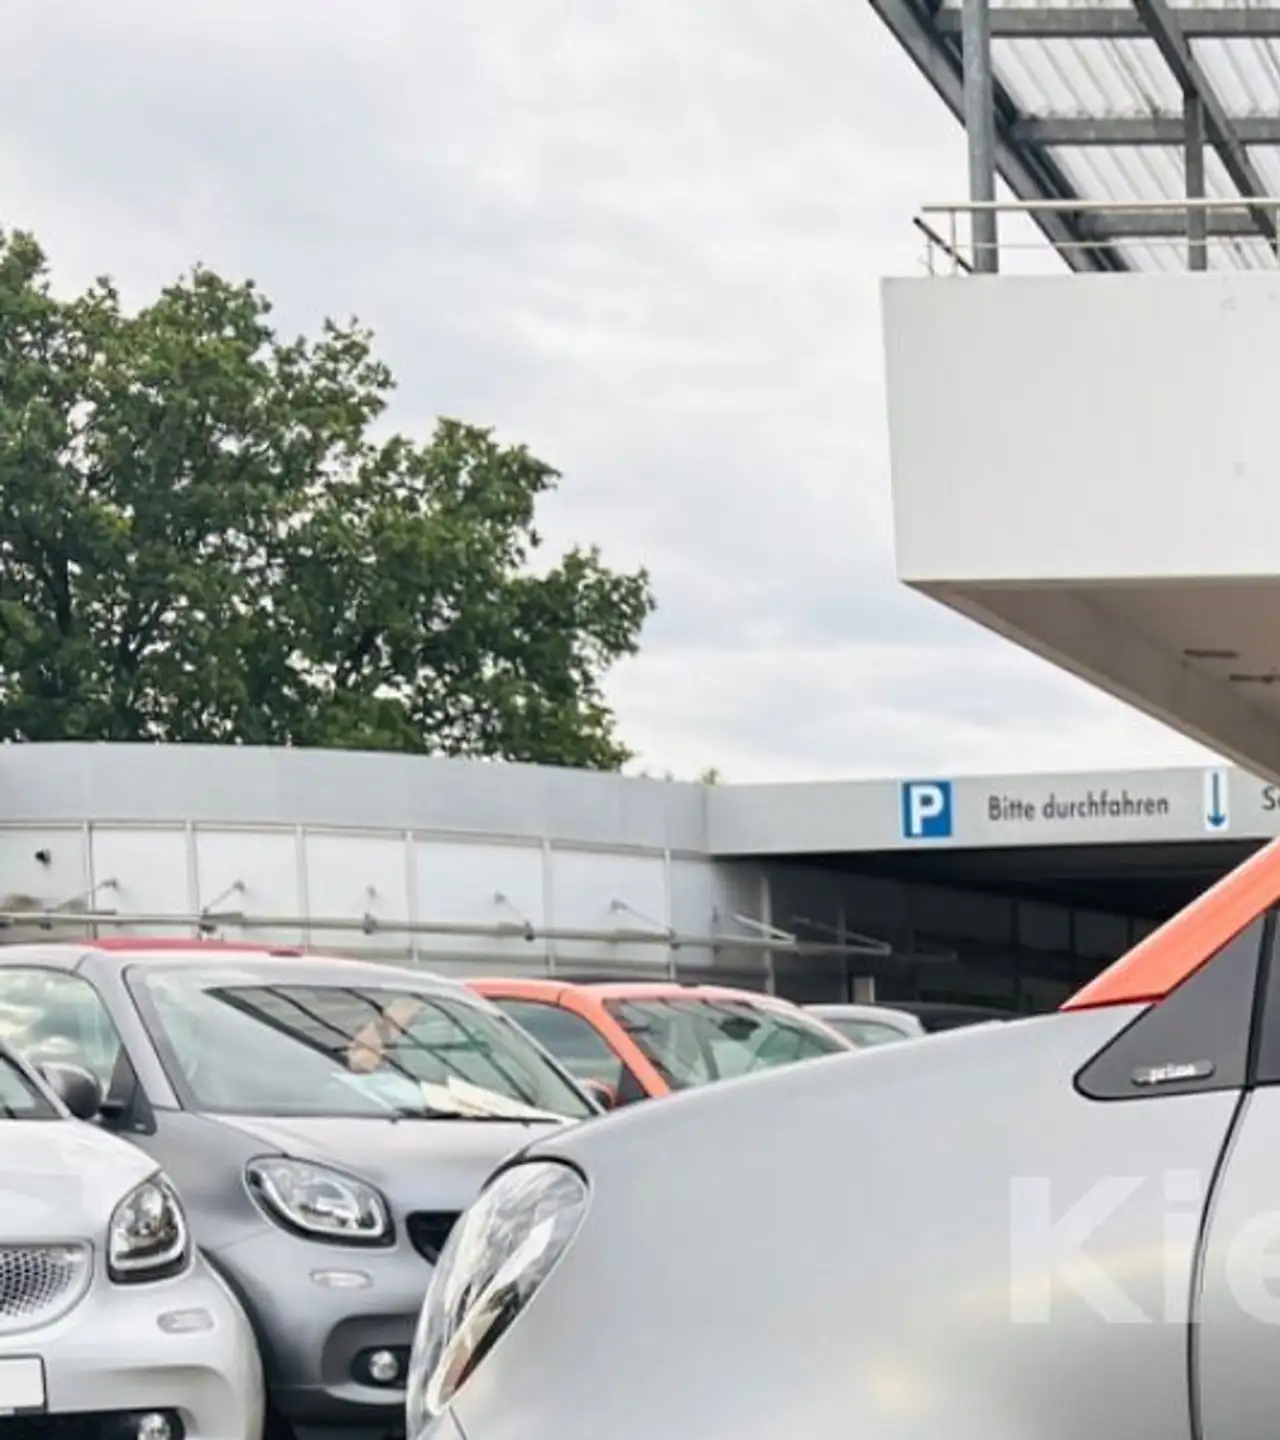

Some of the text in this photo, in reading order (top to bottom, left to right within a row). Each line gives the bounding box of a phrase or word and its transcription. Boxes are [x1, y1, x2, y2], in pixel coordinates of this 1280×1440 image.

[910, 784, 943, 835] P
[988, 789, 1169, 821] Bitte durchfahren
